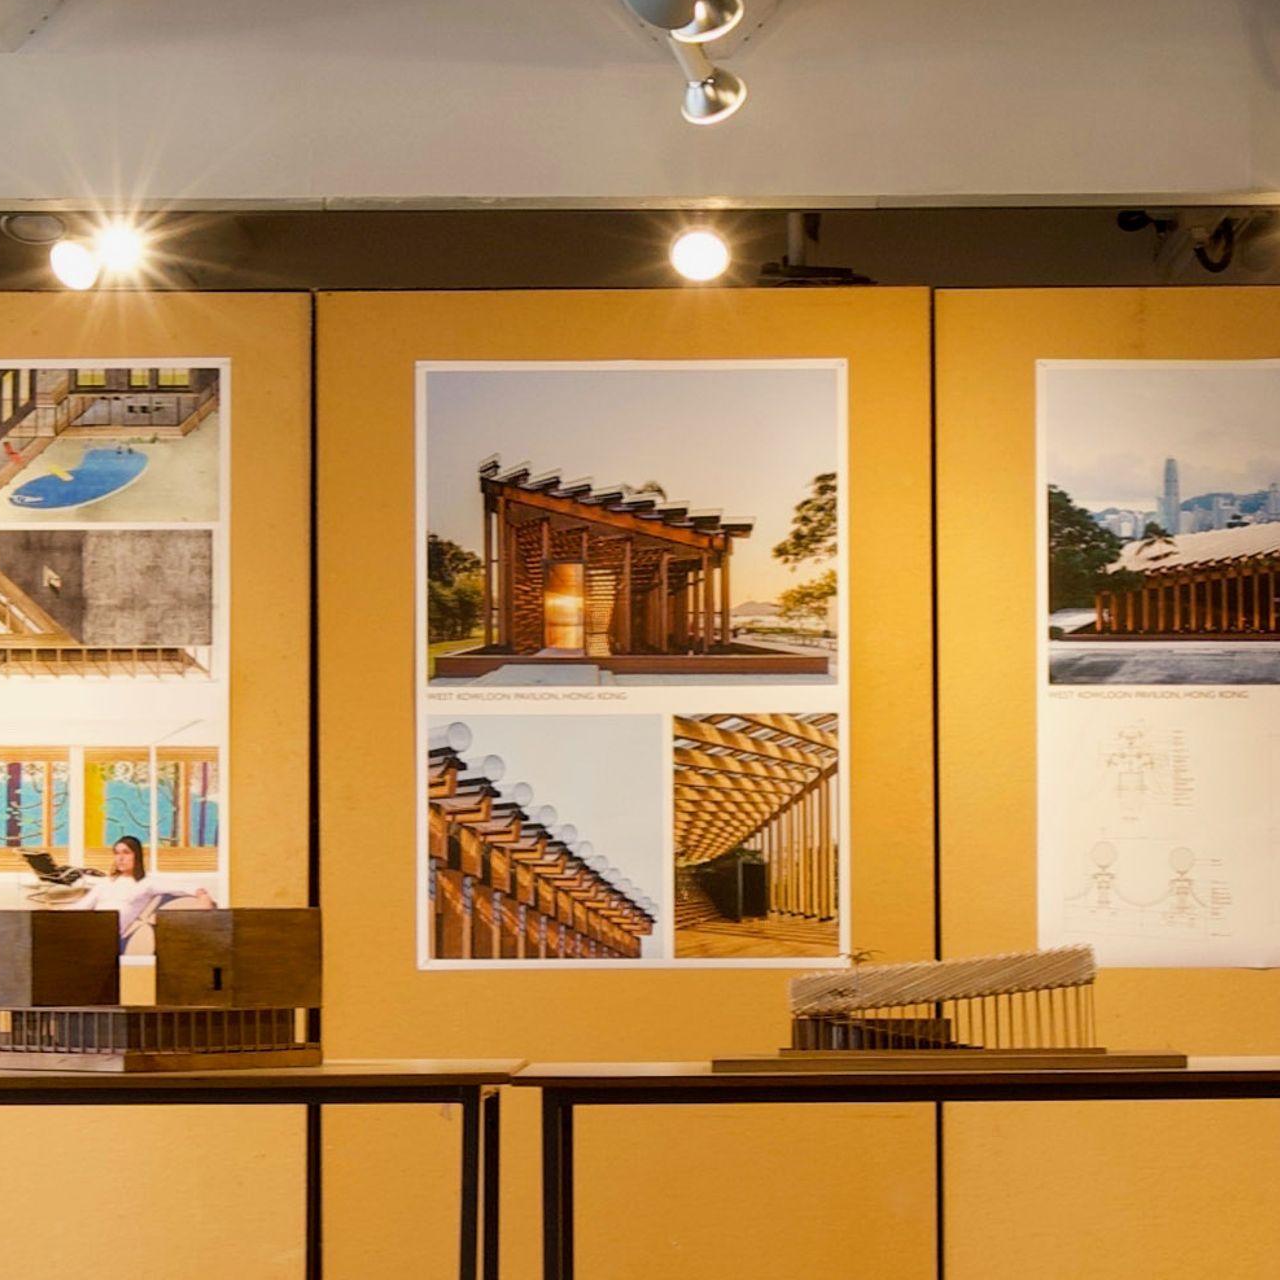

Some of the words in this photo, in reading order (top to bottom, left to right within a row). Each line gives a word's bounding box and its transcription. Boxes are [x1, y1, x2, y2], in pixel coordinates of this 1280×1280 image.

[426, 691, 453, 701] WEST
[455, 691, 511, 701] KOWLOON
[561, 691, 595, 701] HONG
[596, 691, 627, 701] KONG
[1076, 689, 1133, 700] KOWLOON
[1183, 689, 1216, 700] HONG
[1217, 689, 1249, 700] KONG
